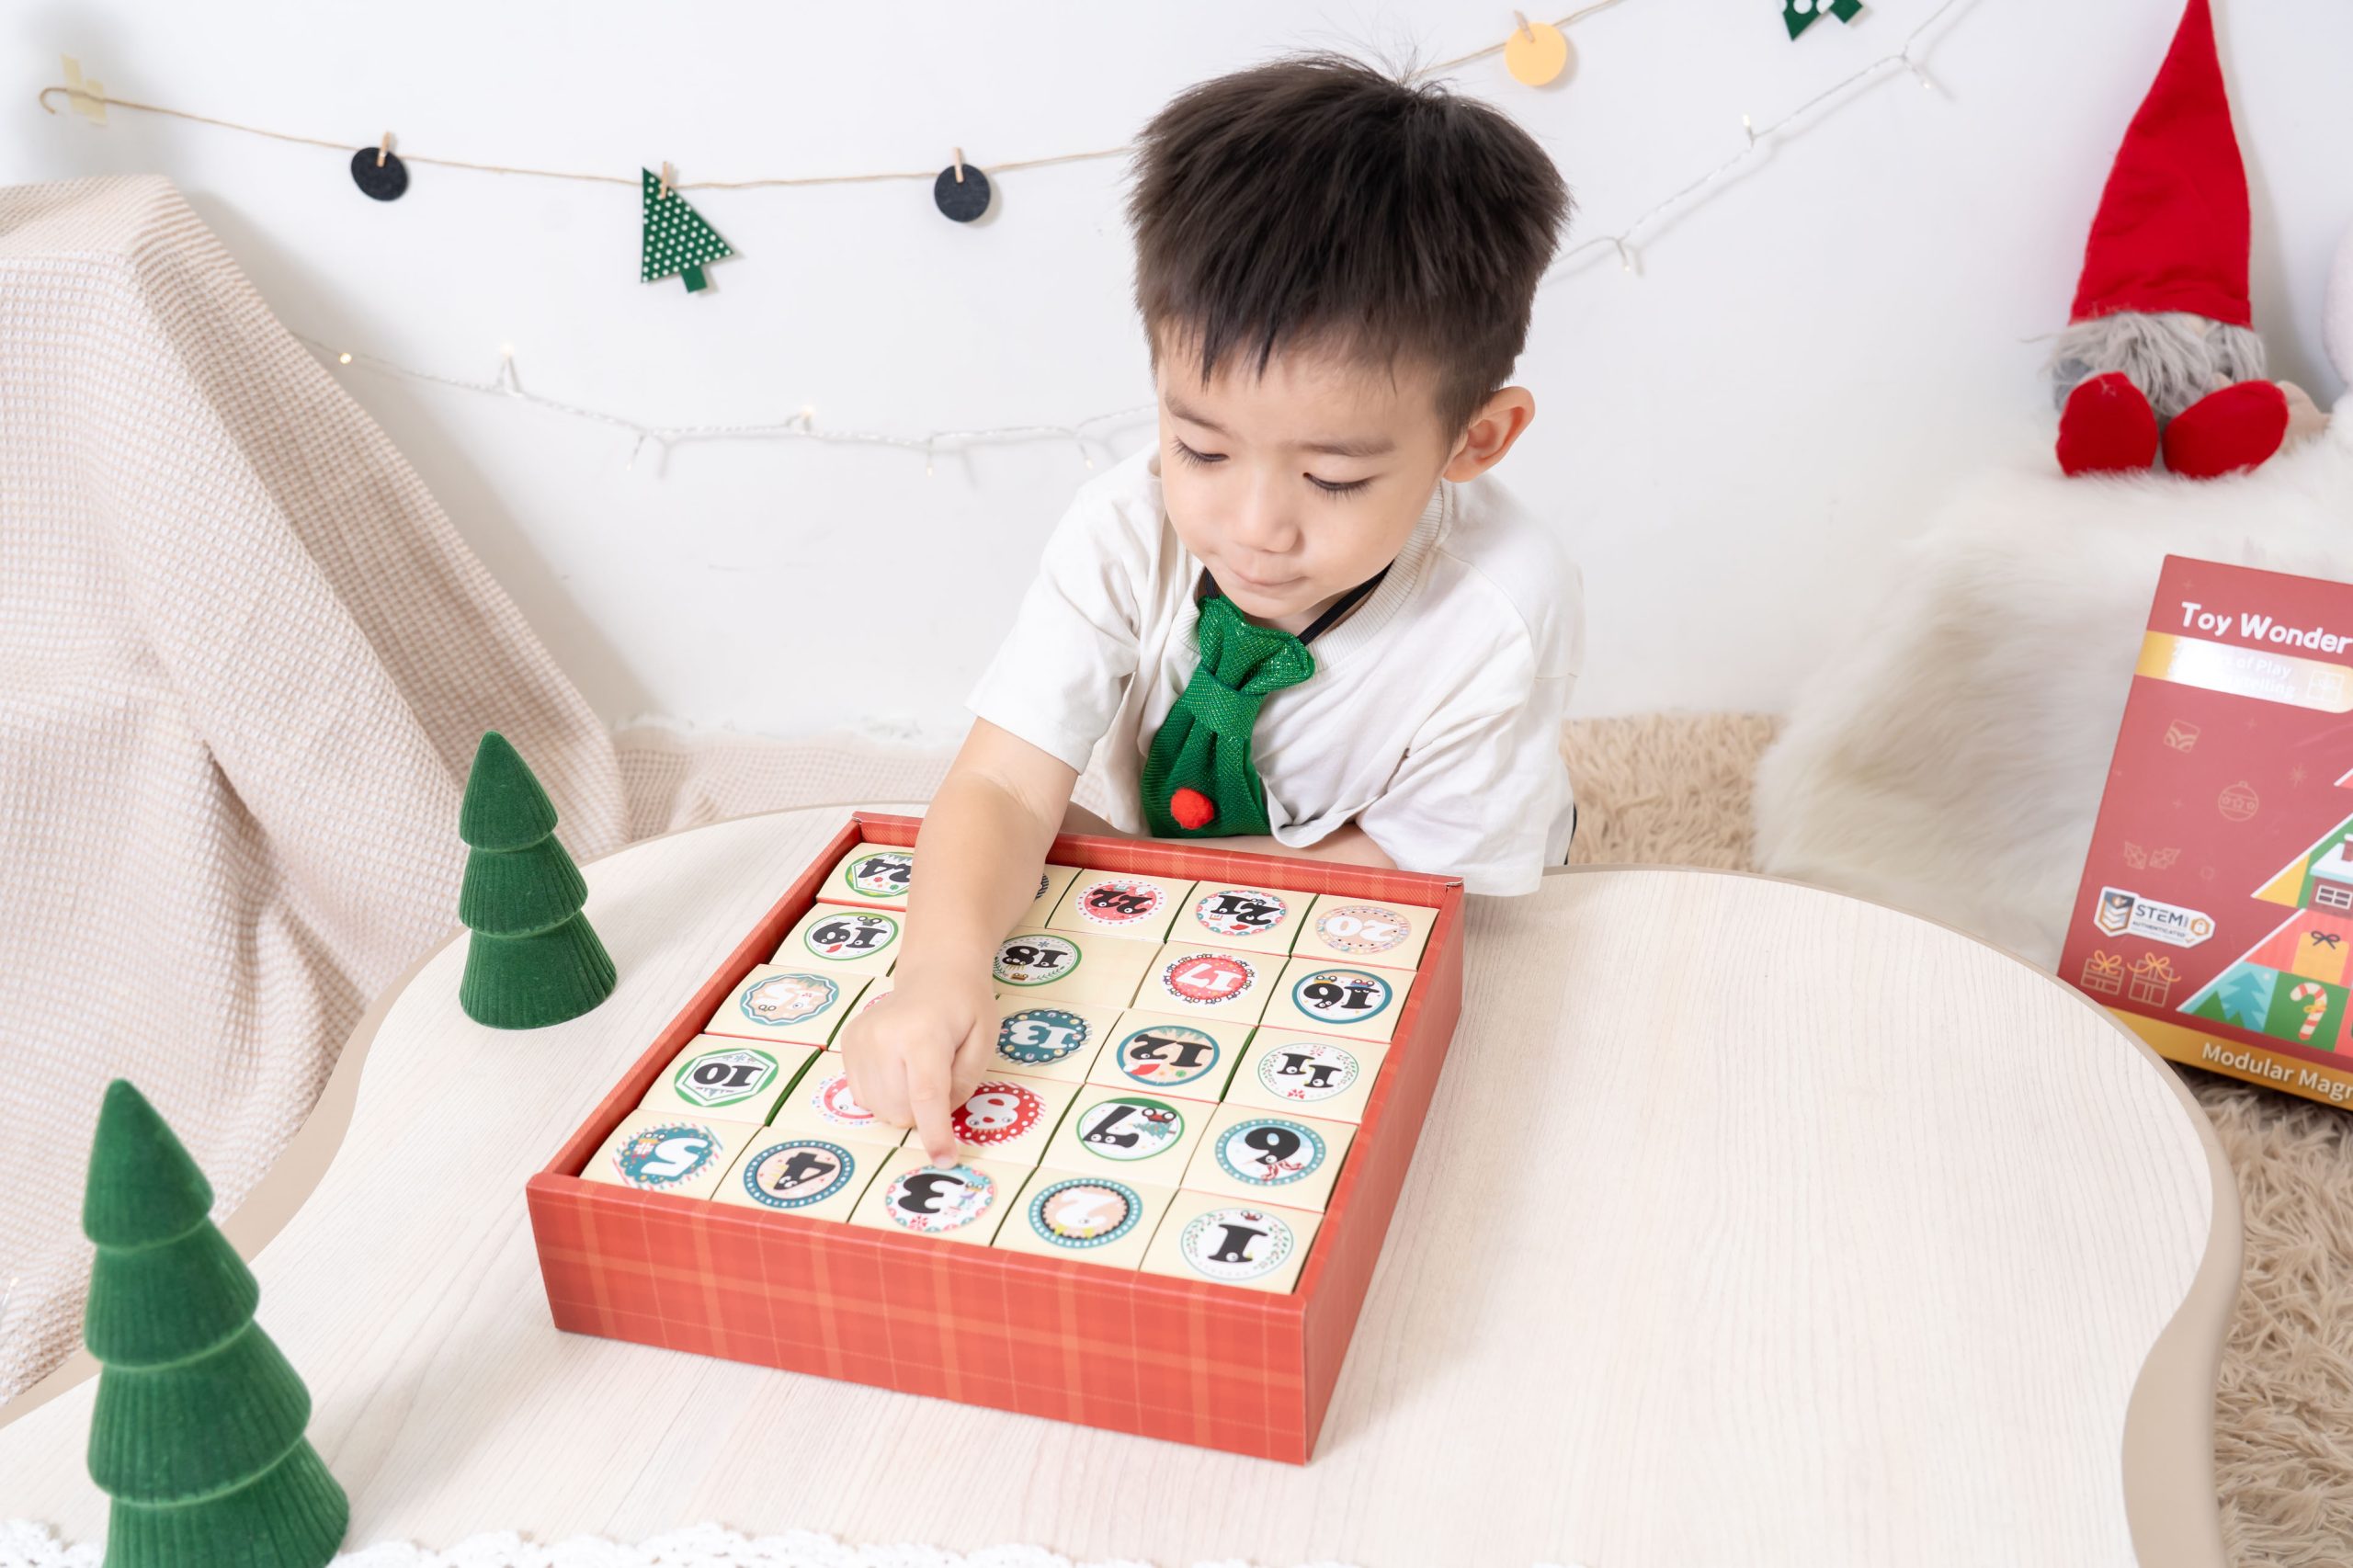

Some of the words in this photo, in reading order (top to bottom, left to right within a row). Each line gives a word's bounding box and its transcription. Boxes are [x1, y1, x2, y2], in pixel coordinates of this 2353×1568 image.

[2181, 601, 2233, 636] Toy
[2240, 613, 2353, 654] Wonder
[1090, 889, 1153, 914] 22
[1211, 894, 1280, 926] 21
[2135, 904, 2185, 926] STEM
[1325, 916, 1400, 942] 20
[1002, 945, 1068, 969] 18
[1176, 962, 1242, 992] 17
[1009, 1020, 1076, 1050] 13
[1130, 1033, 1213, 1067] 12
[693, 1062, 763, 1087] 10
[1277, 1052, 1342, 1088] 11
[2201, 1042, 2294, 1082] Modular
[965, 1092, 1020, 1131] 8
[1083, 1105, 1140, 1148] 7
[640, 1137, 710, 1177] 5
[773, 1152, 835, 1190] 4
[898, 1174, 965, 1214] 3
[1056, 1187, 1118, 1228] 2
[1208, 1223, 1268, 1263] 1
